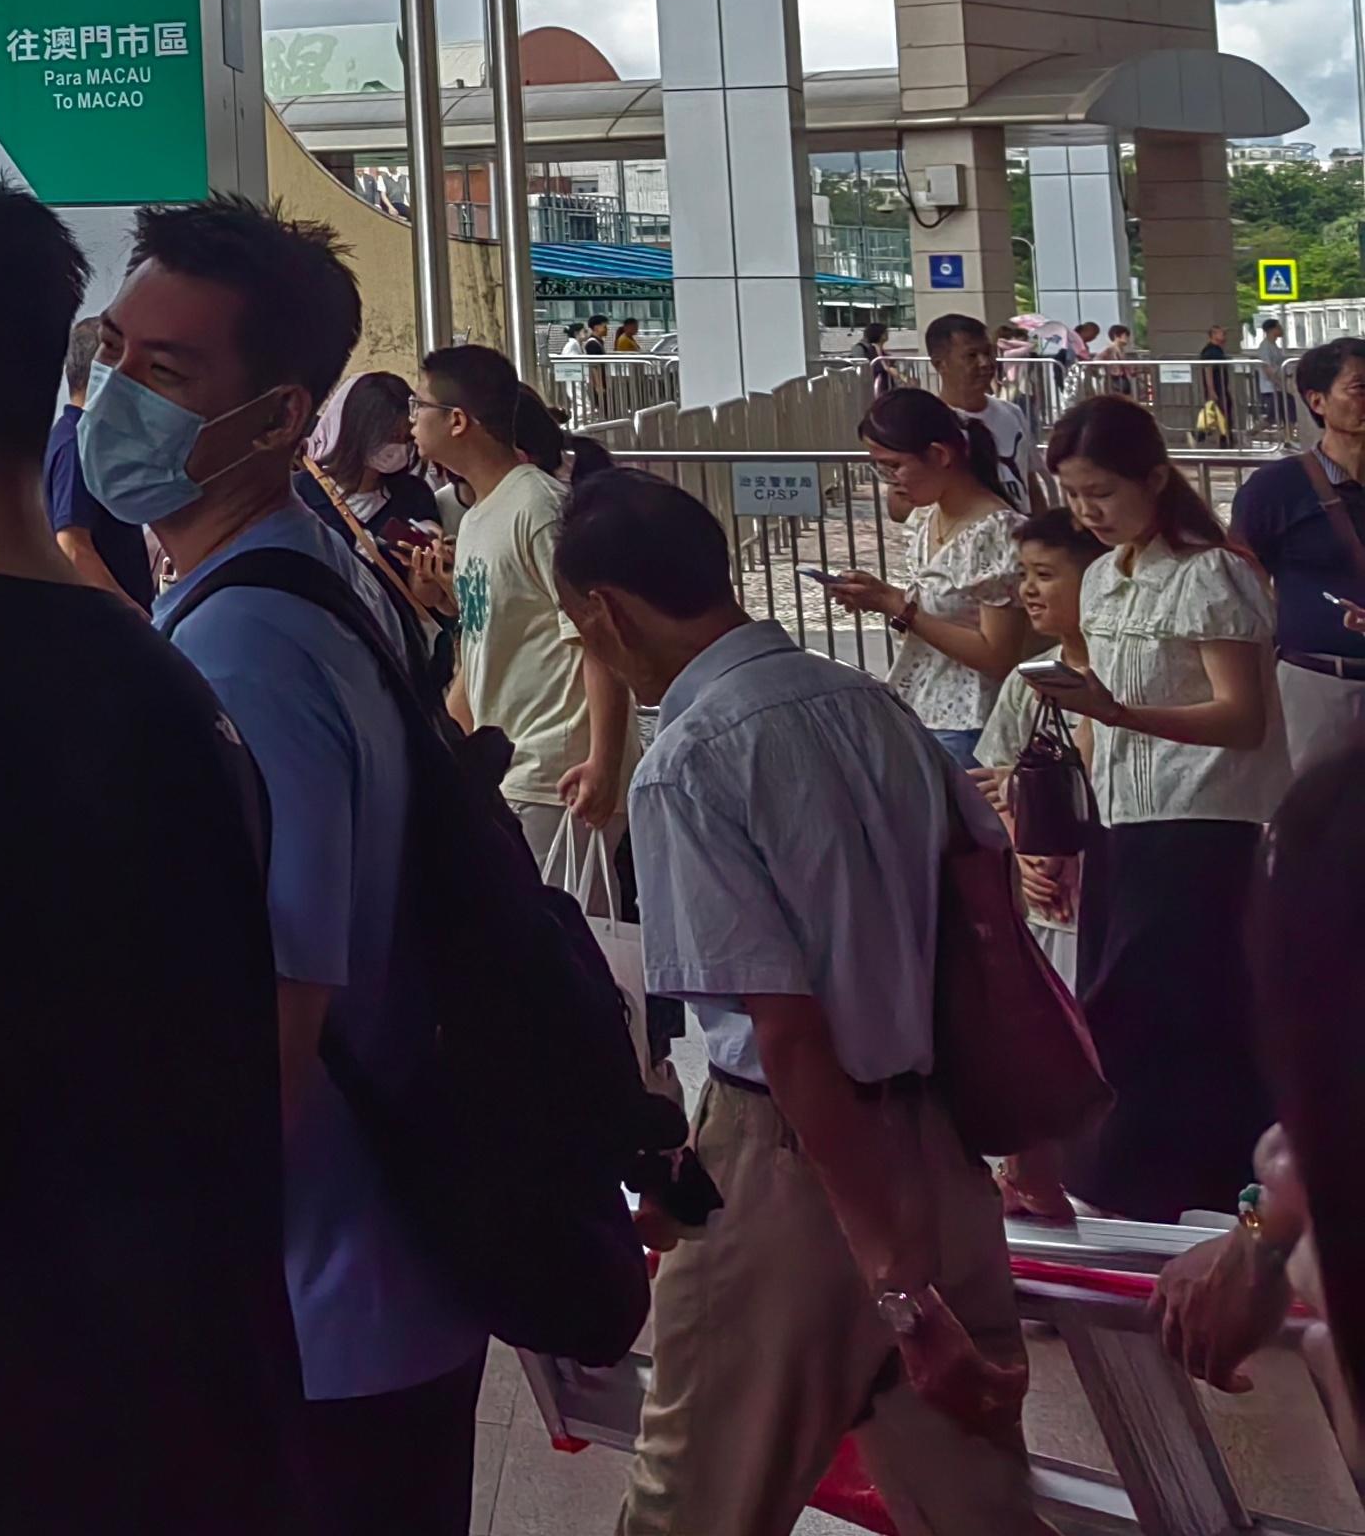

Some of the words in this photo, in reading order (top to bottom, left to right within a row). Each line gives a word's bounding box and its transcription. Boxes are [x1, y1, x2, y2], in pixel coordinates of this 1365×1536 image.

[6, 21, 190, 63] 往澳門市區
[44, 69, 83, 86] Para
[86, 66, 152, 84] MACAU
[53, 93, 74, 110] To
[77, 90, 144, 109] MACAO
